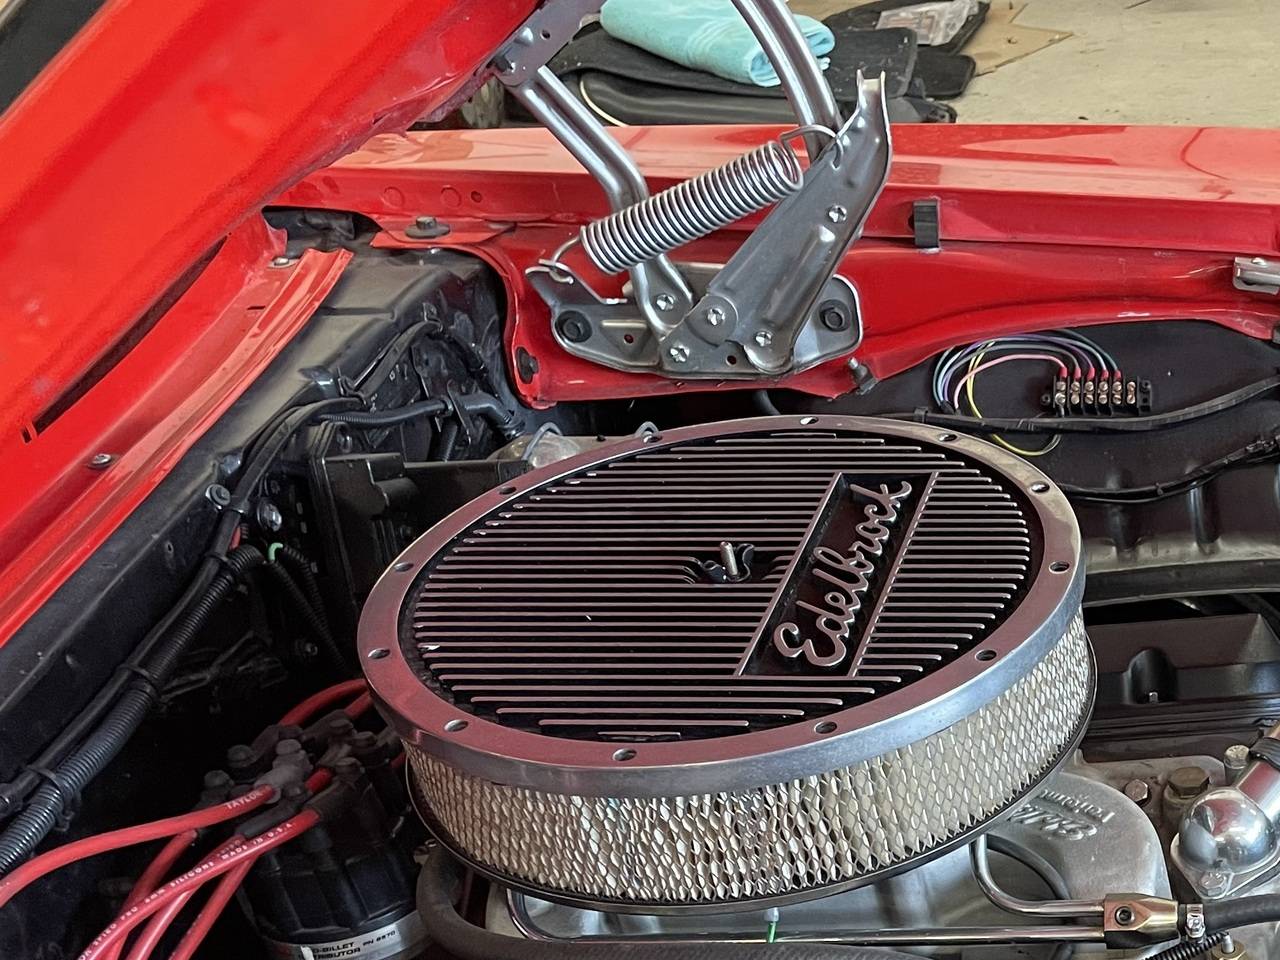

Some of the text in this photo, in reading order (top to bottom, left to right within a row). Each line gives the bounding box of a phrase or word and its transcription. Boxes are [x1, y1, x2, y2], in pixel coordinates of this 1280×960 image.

[773, 480, 913, 667] Edelbrock
[169, 860, 216, 889] SILICONE
[221, 843, 248, 861] MADE
